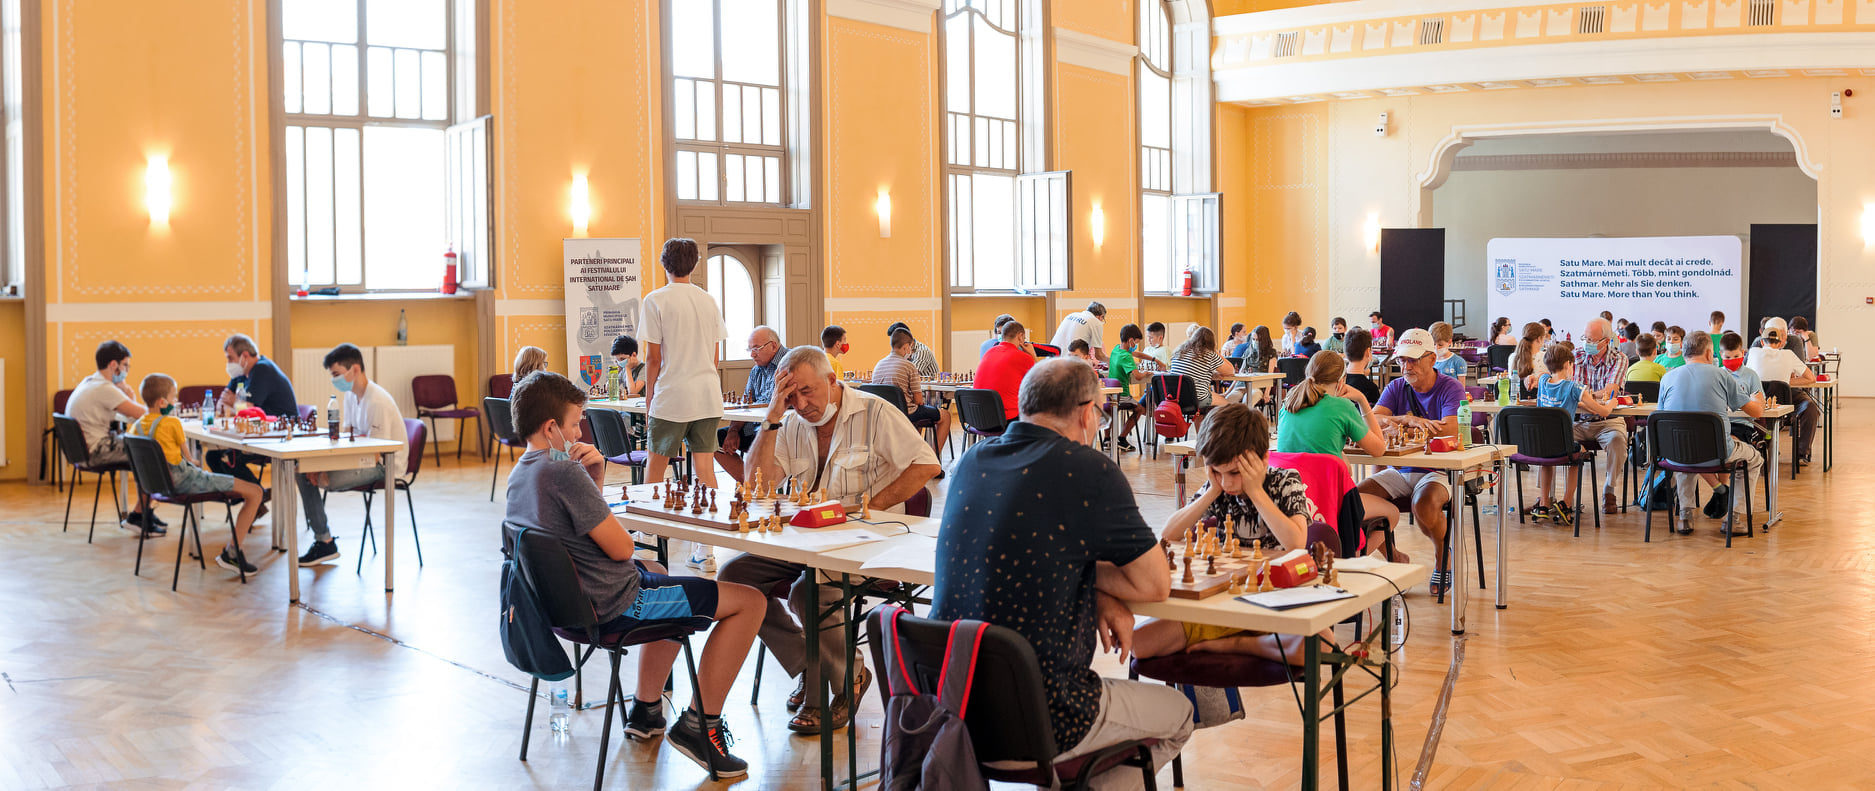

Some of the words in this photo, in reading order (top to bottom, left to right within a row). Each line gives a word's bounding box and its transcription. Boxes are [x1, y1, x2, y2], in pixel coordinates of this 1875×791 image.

[603, 257, 635, 265] PRINCIPALI
[1560, 259, 1580, 267] Satu
[1581, 259, 1606, 267] Mare.
[1607, 258, 1623, 266] Mai
[1625, 258, 1647, 266] mult
[1648, 258, 1674, 266] decât
[1675, 257, 1684, 266] ai
[1685, 257, 1714, 266] crede.
[1560, 269, 1631, 277] Szatmárnémeti.
[1631, 269, 1657, 278] Több,
[1658, 268, 1680, 277] mint
[1681, 268, 1734, 278] gondolnád.
[569, 276, 616, 285] INTERNAȚIONAL
[625, 275, 637, 284] ȘAH
[1560, 280, 1600, 288] Sathmar.
[1601, 280, 1625, 288] Mehr
[1626, 280, 1639, 288] als
[1640, 279, 1654, 287] Sie
[1655, 279, 1692, 288] denken.
[587, 284, 603, 292] SATU
[1560, 290, 1580, 298] Satu
[1582, 290, 1606, 298] Mare.
[1607, 290, 1630, 298] More
[1631, 290, 1653, 298] than
[1654, 290, 1671, 298] You
[1673, 289, 1700, 298] think.
